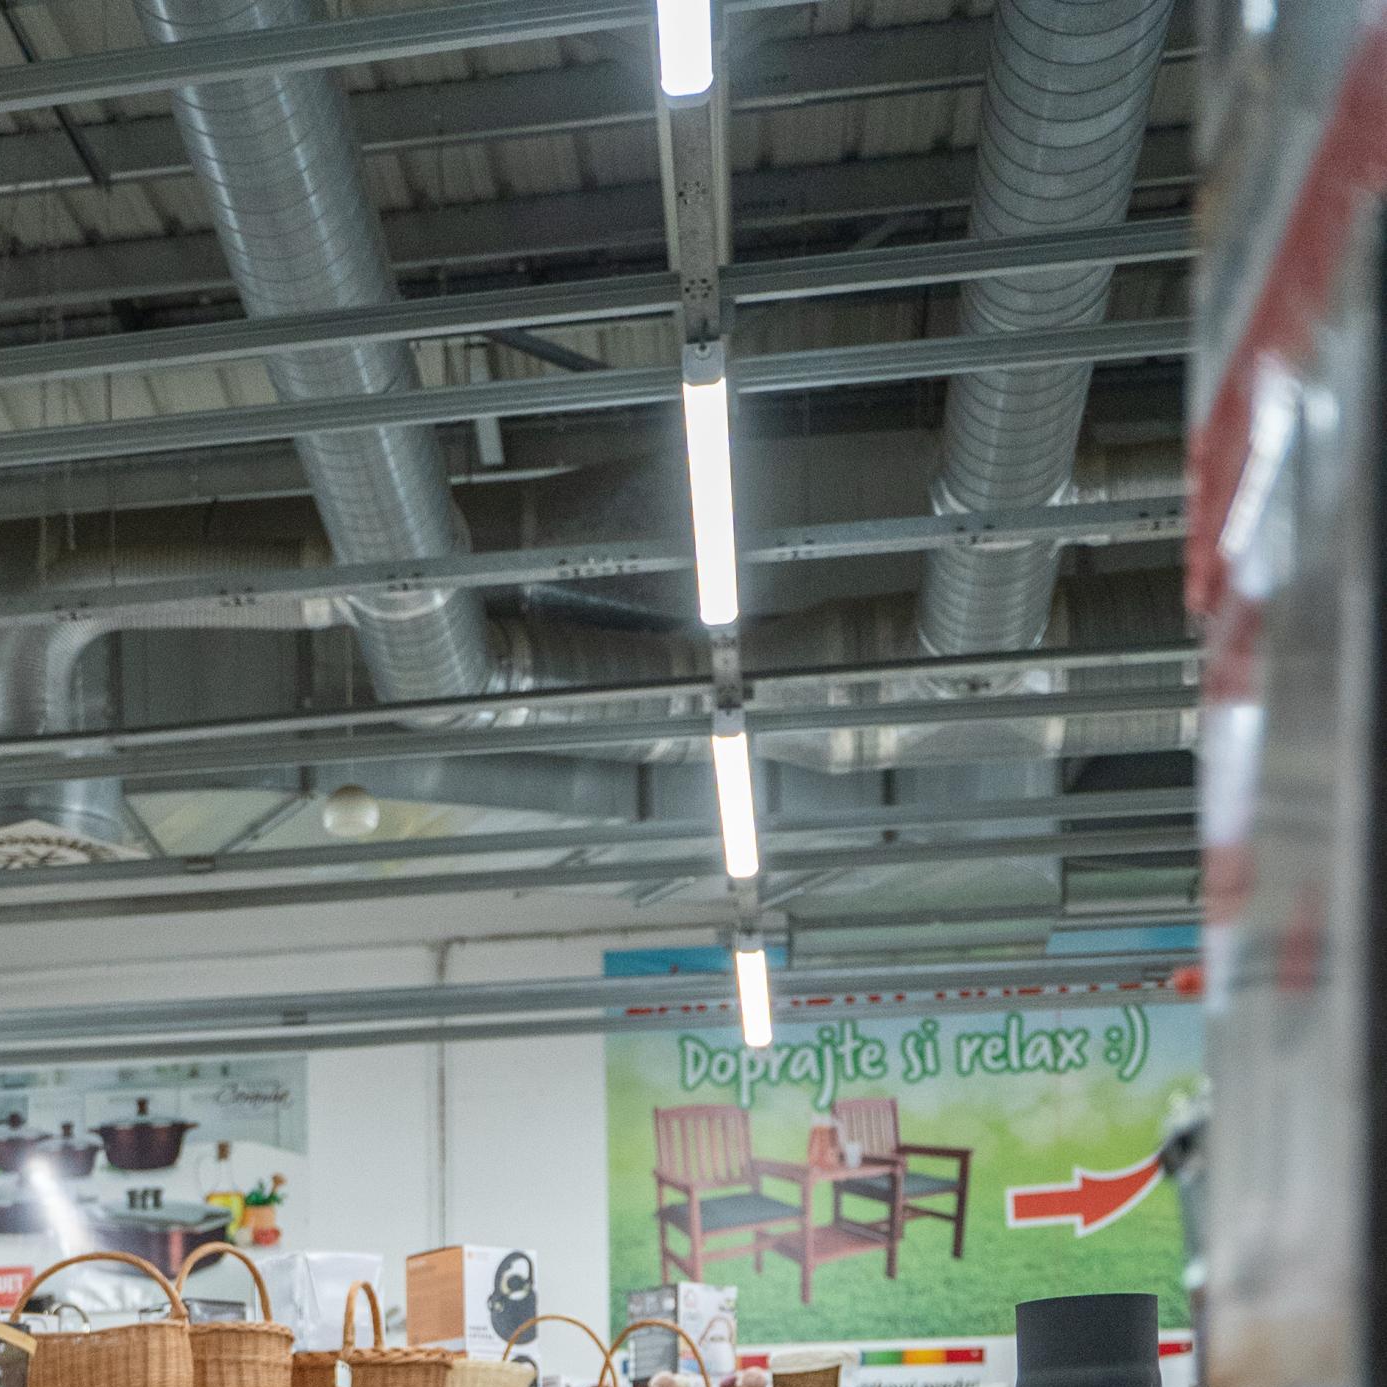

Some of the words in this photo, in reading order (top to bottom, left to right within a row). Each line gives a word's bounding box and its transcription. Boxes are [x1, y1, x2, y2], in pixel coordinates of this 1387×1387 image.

[679, 1017, 889, 1111] Doprajte
[901, 1018, 941, 1083] si
[957, 1012, 1091, 1076] relax
